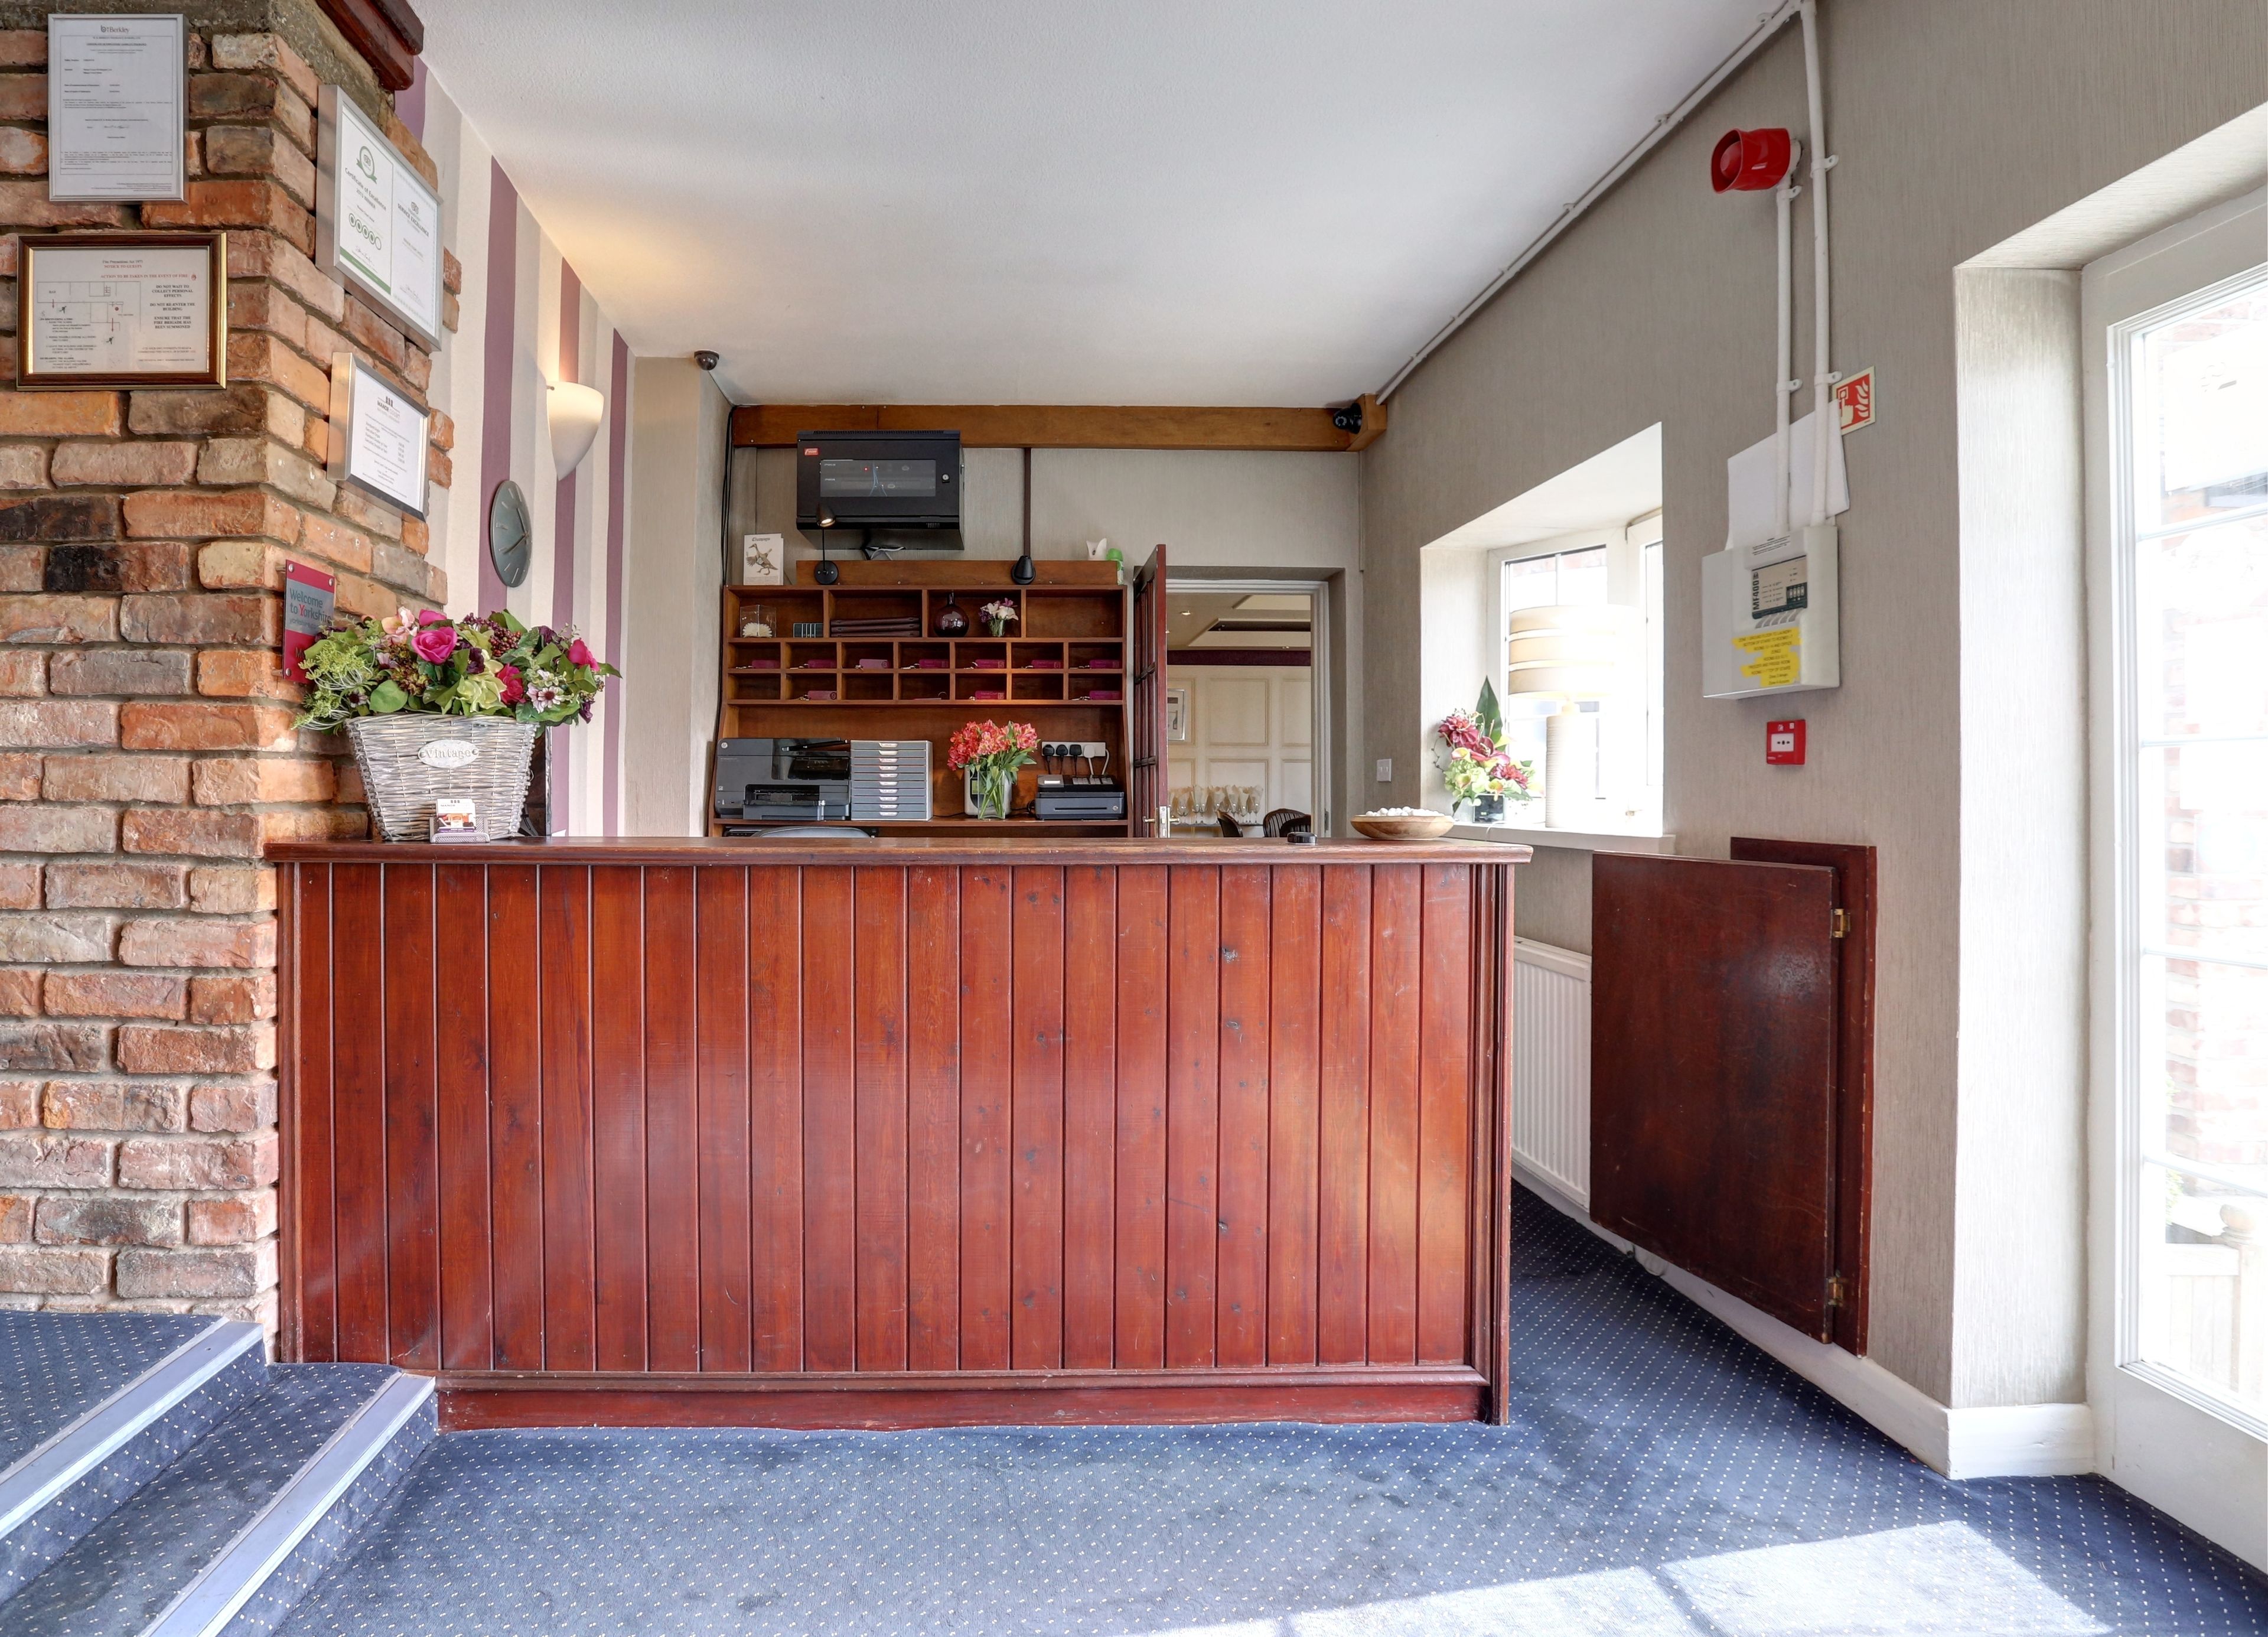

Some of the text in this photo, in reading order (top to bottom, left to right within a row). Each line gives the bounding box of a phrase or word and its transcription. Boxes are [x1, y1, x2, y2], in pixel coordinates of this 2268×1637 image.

[345, 167, 364, 189] Certificate
[369, 190, 386, 211] Excellence
[410, 216, 429, 237] EXCELLENCE
[289, 587, 323, 608] Welcome
[290, 602, 331, 624] to Yorkshire
[425, 748, 471, 759] Vintage
